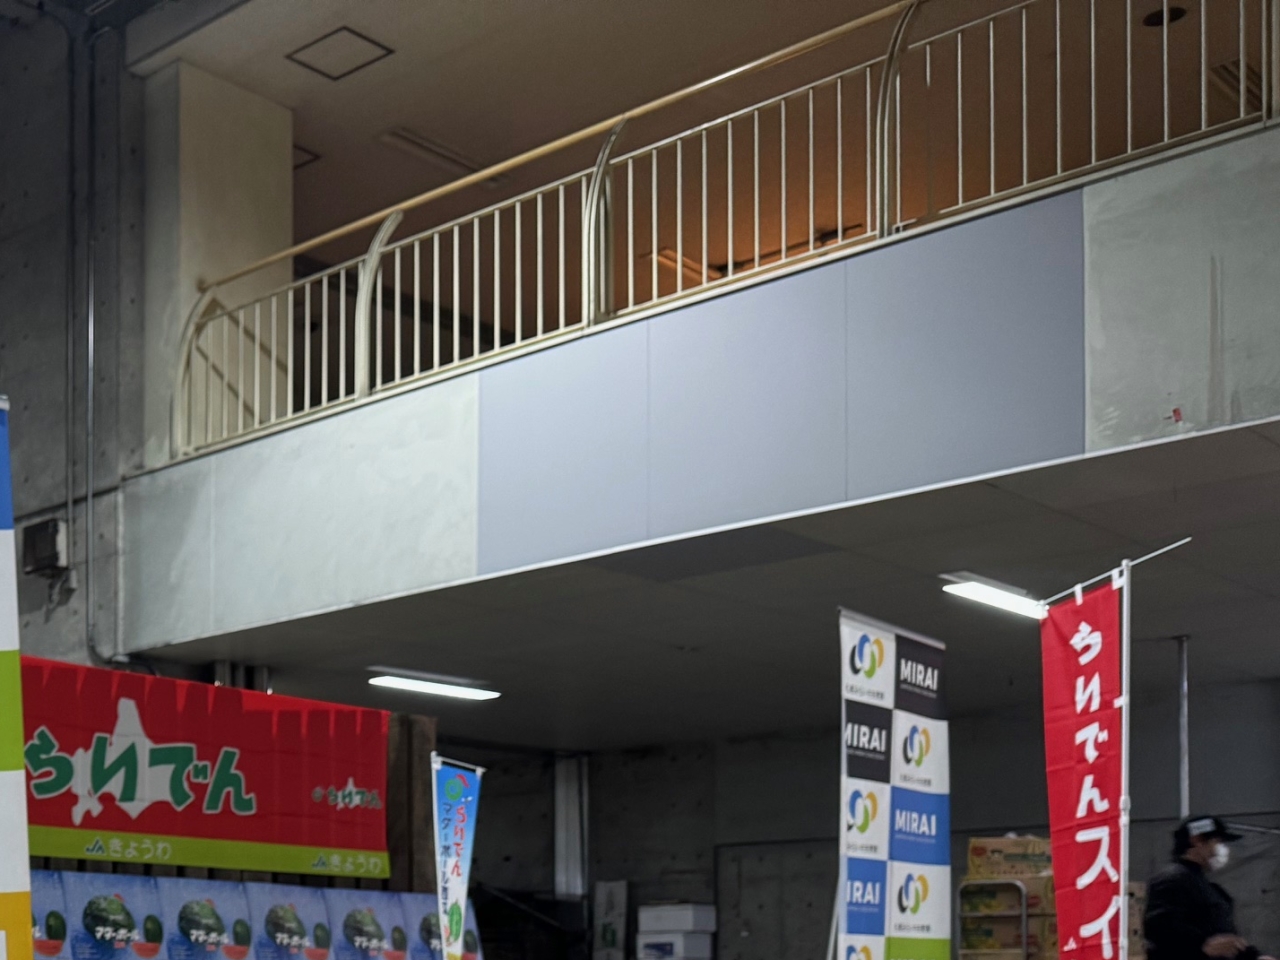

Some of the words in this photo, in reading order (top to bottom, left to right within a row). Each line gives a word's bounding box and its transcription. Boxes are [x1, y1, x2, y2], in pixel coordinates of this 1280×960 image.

[899, 658, 938, 691] MIRAI
[24, 725, 257, 815] らいでん
[895, 809, 937, 837] MIRAI
[108, 838, 173, 860] きょうわ
[847, 880, 880, 904] IRAI
